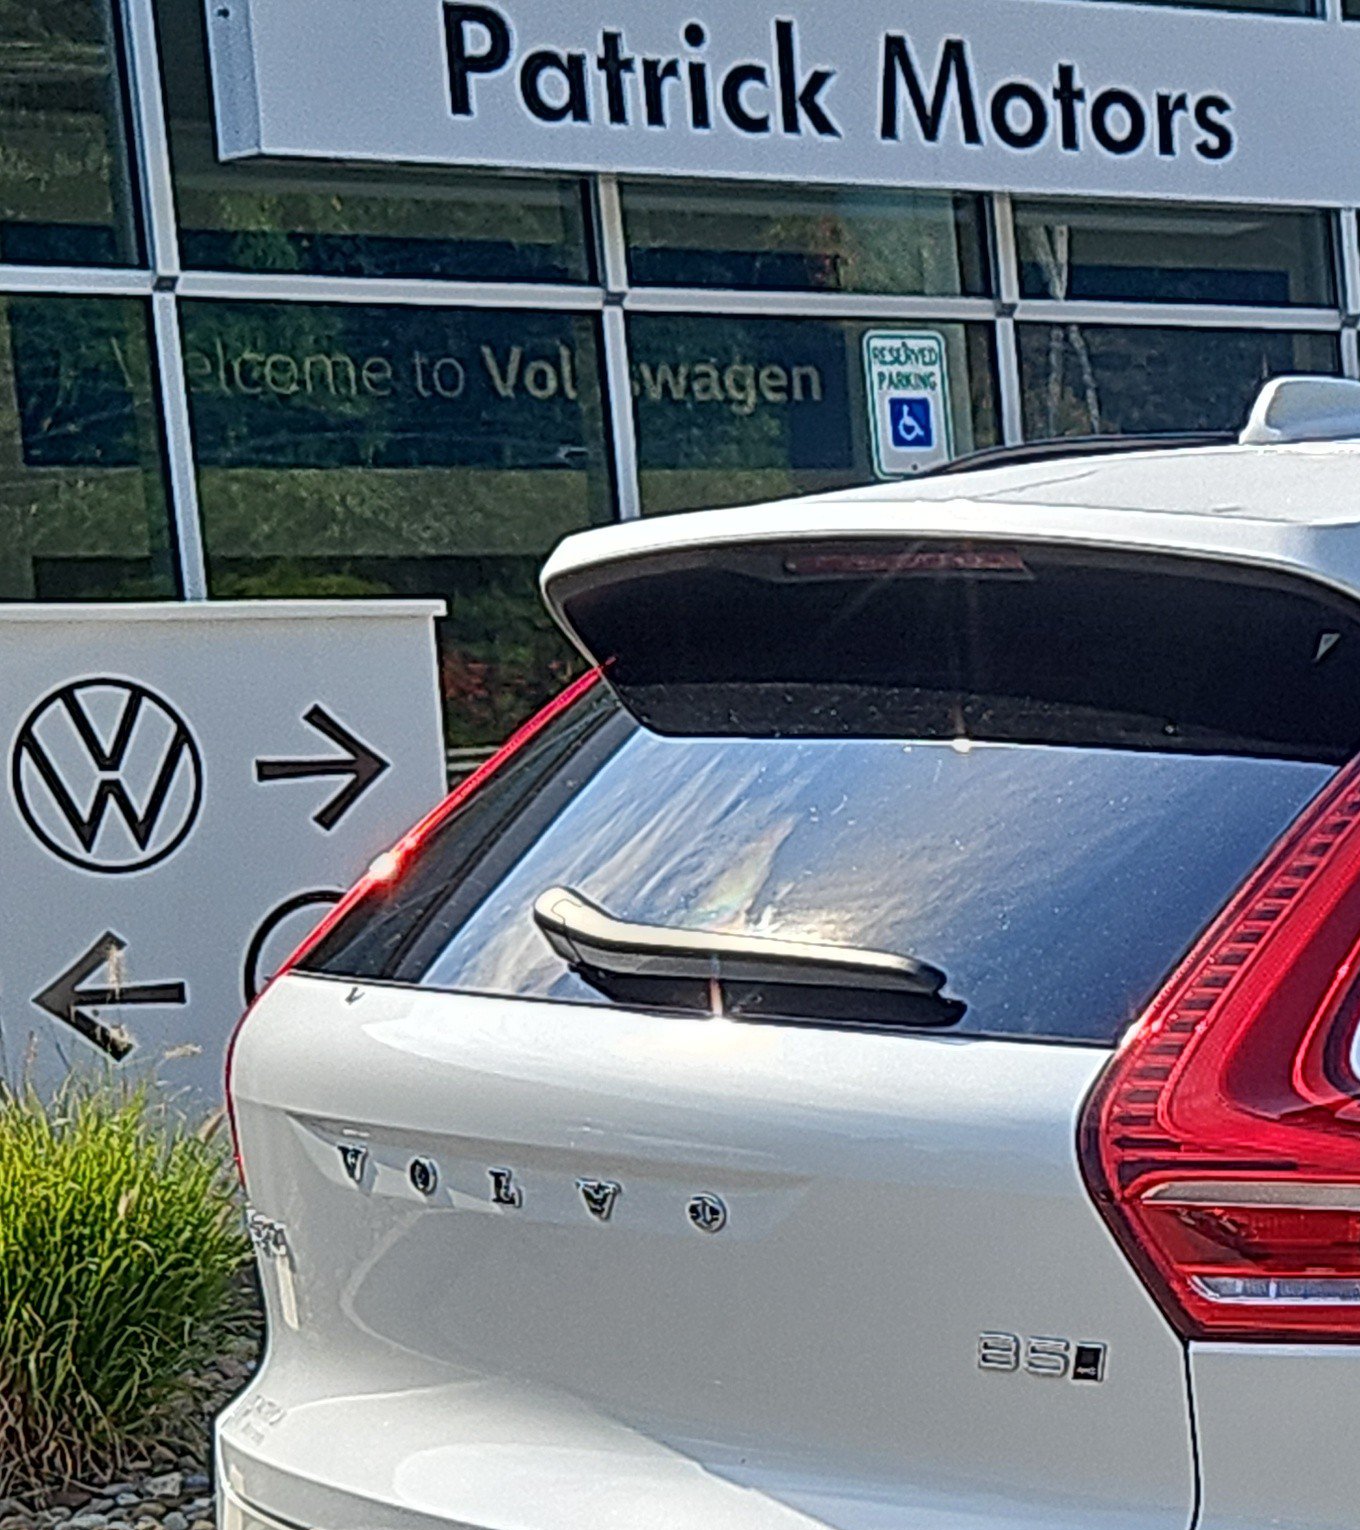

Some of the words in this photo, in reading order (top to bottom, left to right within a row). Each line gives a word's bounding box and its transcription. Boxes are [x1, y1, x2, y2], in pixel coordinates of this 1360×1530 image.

[444, 2, 838, 138] Patrick
[880, 34, 1233, 159] Motors
[111, 337, 393, 396] elcome
[413, 351, 463, 397] to
[482, 345, 821, 415] Volwagen
[871, 342, 938, 365] RESERVED
[877, 371, 937, 390] PARKING
[337, 1145, 727, 1233] VOLVO
